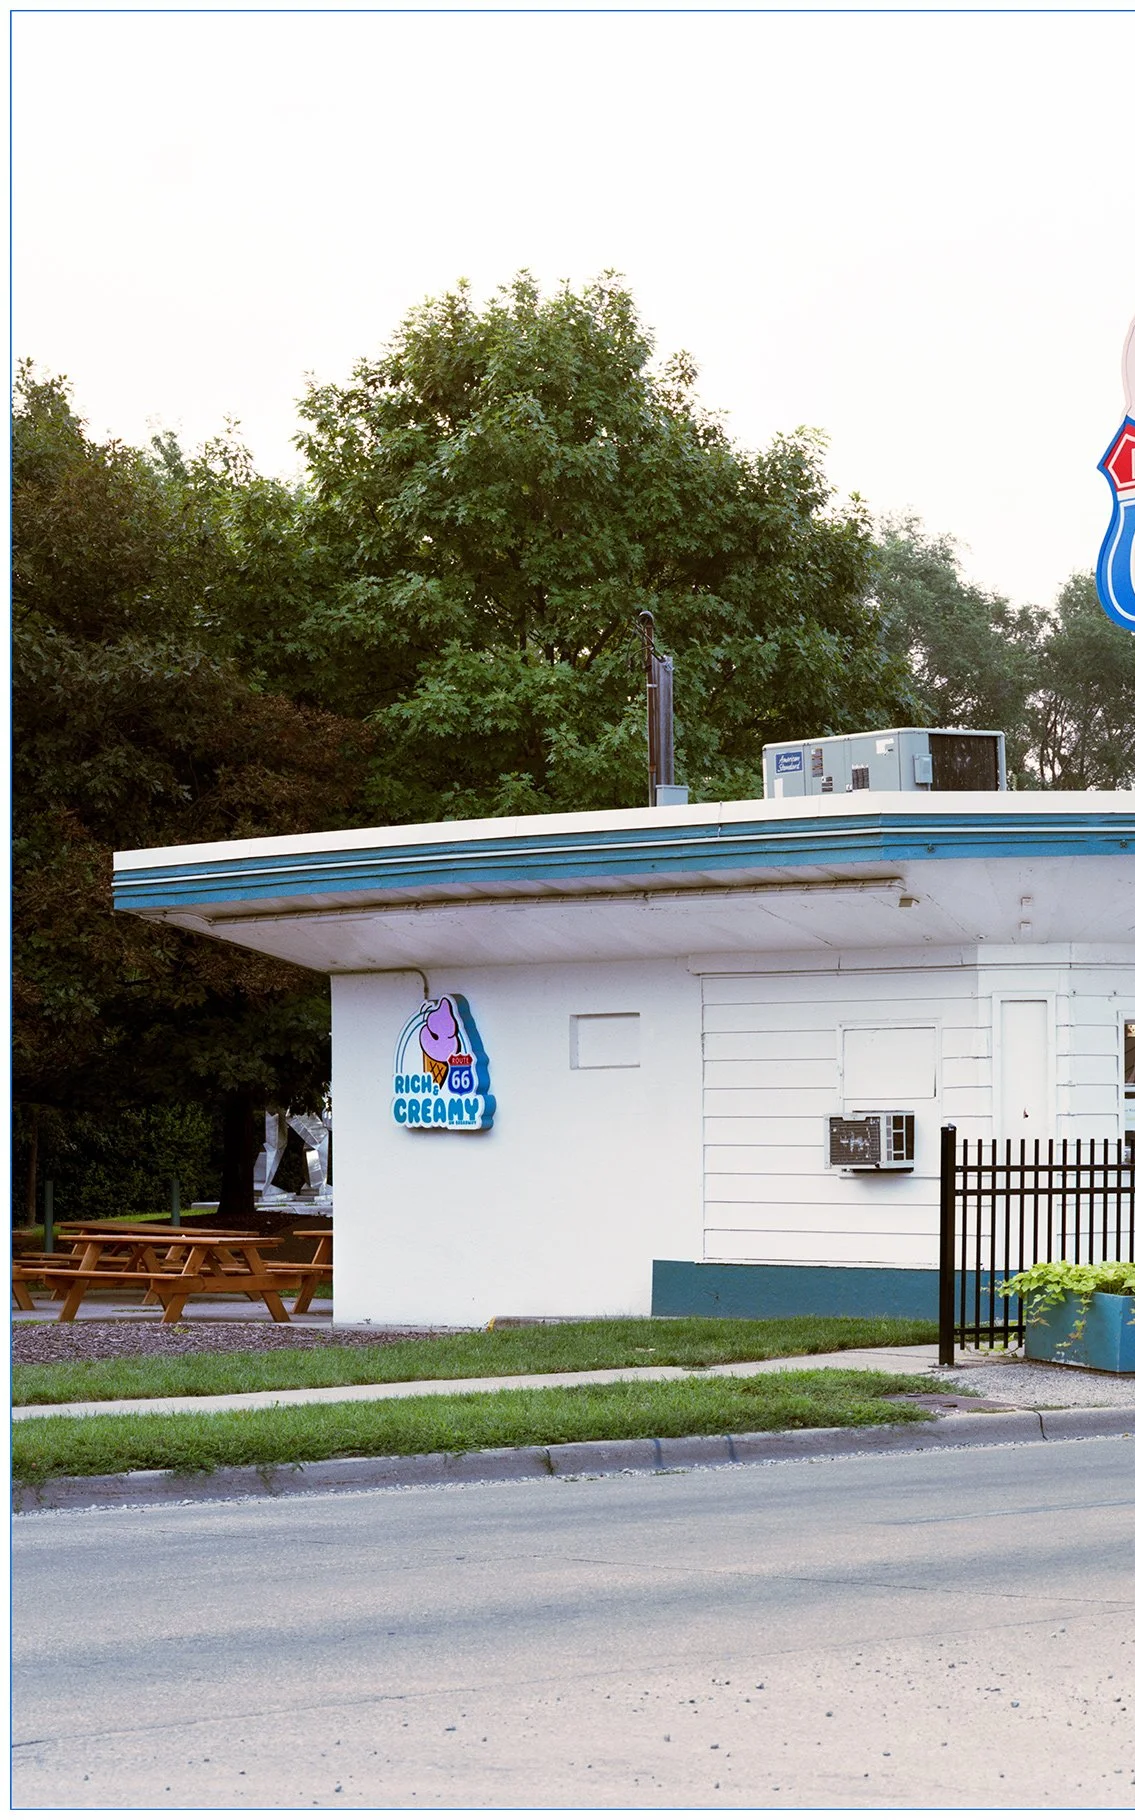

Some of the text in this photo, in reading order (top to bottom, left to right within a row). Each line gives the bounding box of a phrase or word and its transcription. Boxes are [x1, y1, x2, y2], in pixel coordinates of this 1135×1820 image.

[452, 1056, 469, 1064] ROUTE
[395, 1074, 439, 1096] RICH &
[451, 1070, 470, 1089] 66
[394, 1098, 479, 1124] CREAMY
